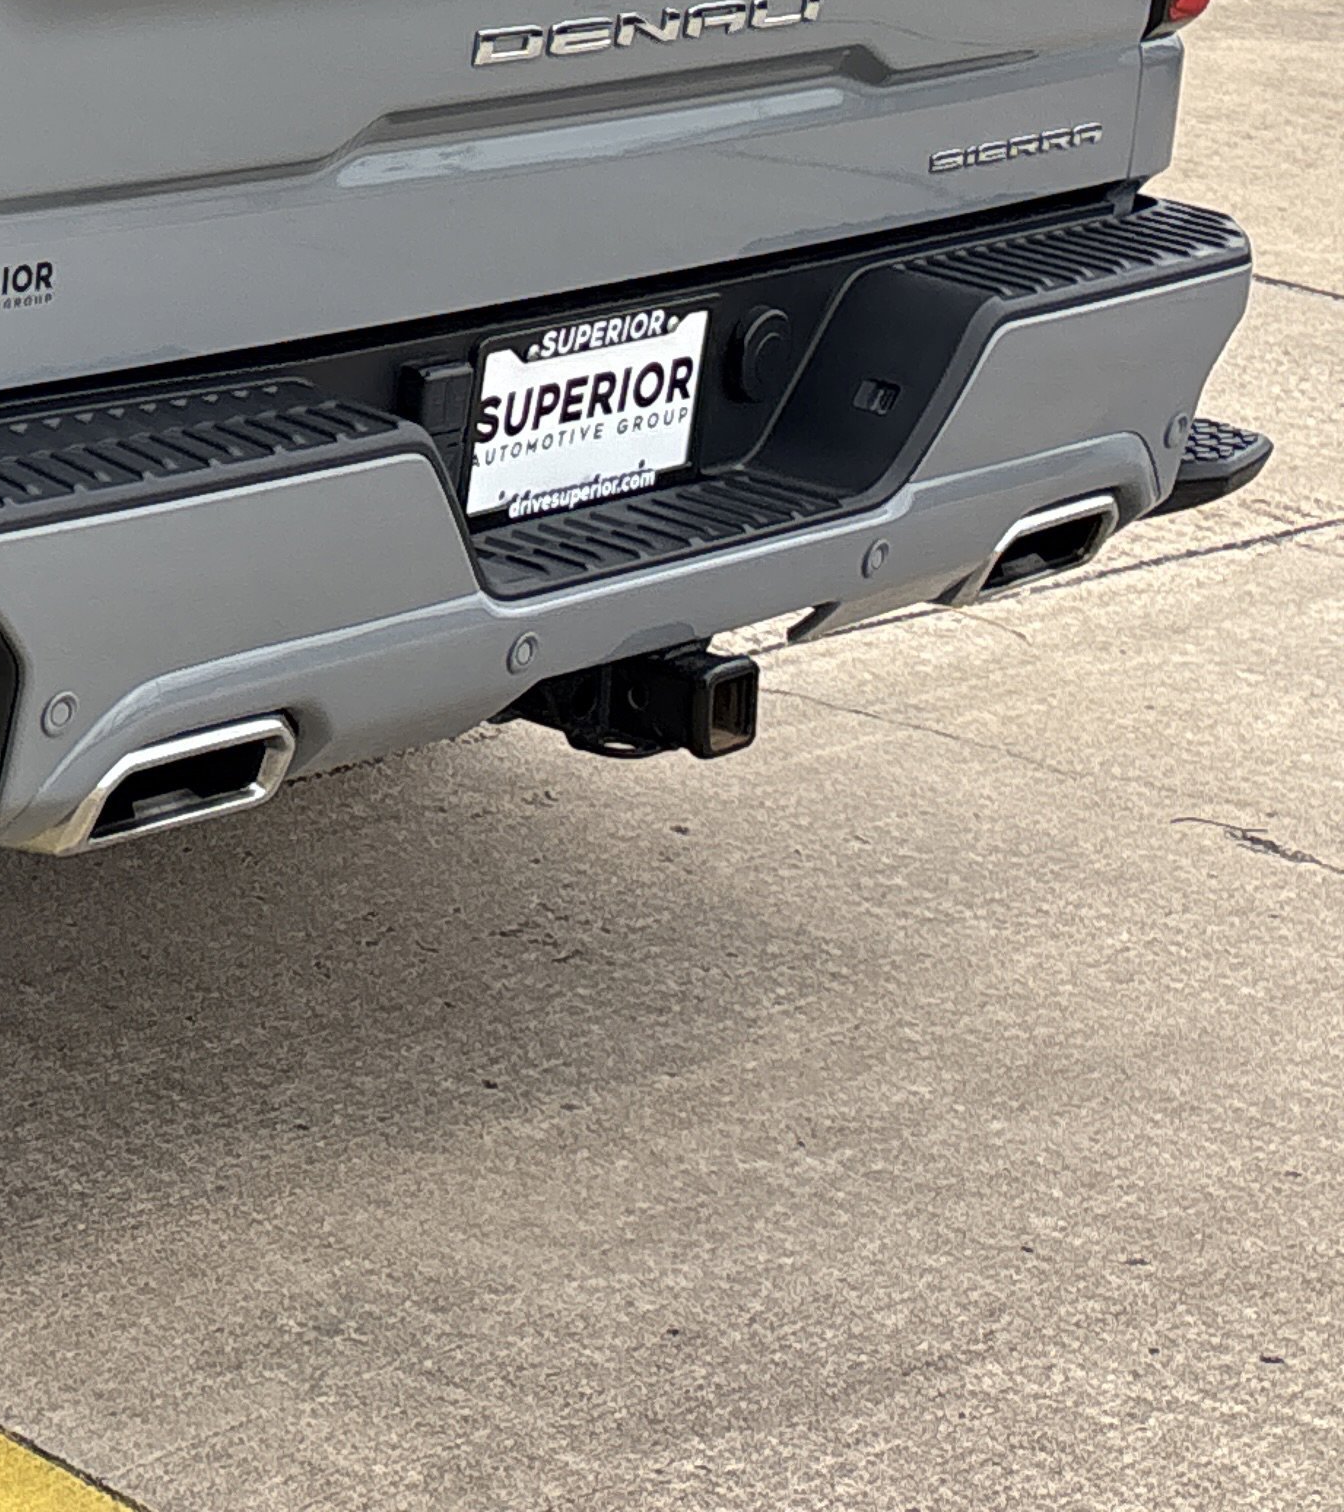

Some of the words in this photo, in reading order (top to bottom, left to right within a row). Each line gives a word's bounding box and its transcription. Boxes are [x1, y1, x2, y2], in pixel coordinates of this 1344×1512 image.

[928, 121, 1103, 173] SIERRA
[3, 292, 53, 310] GROUP
[540, 309, 666, 357] SUPERIOR
[475, 356, 694, 443] SUPERIOR
[472, 422, 605, 468] AUTOMOTIVE
[616, 406, 689, 436] GROUP
[508, 469, 656, 519] drivesuperior.com
